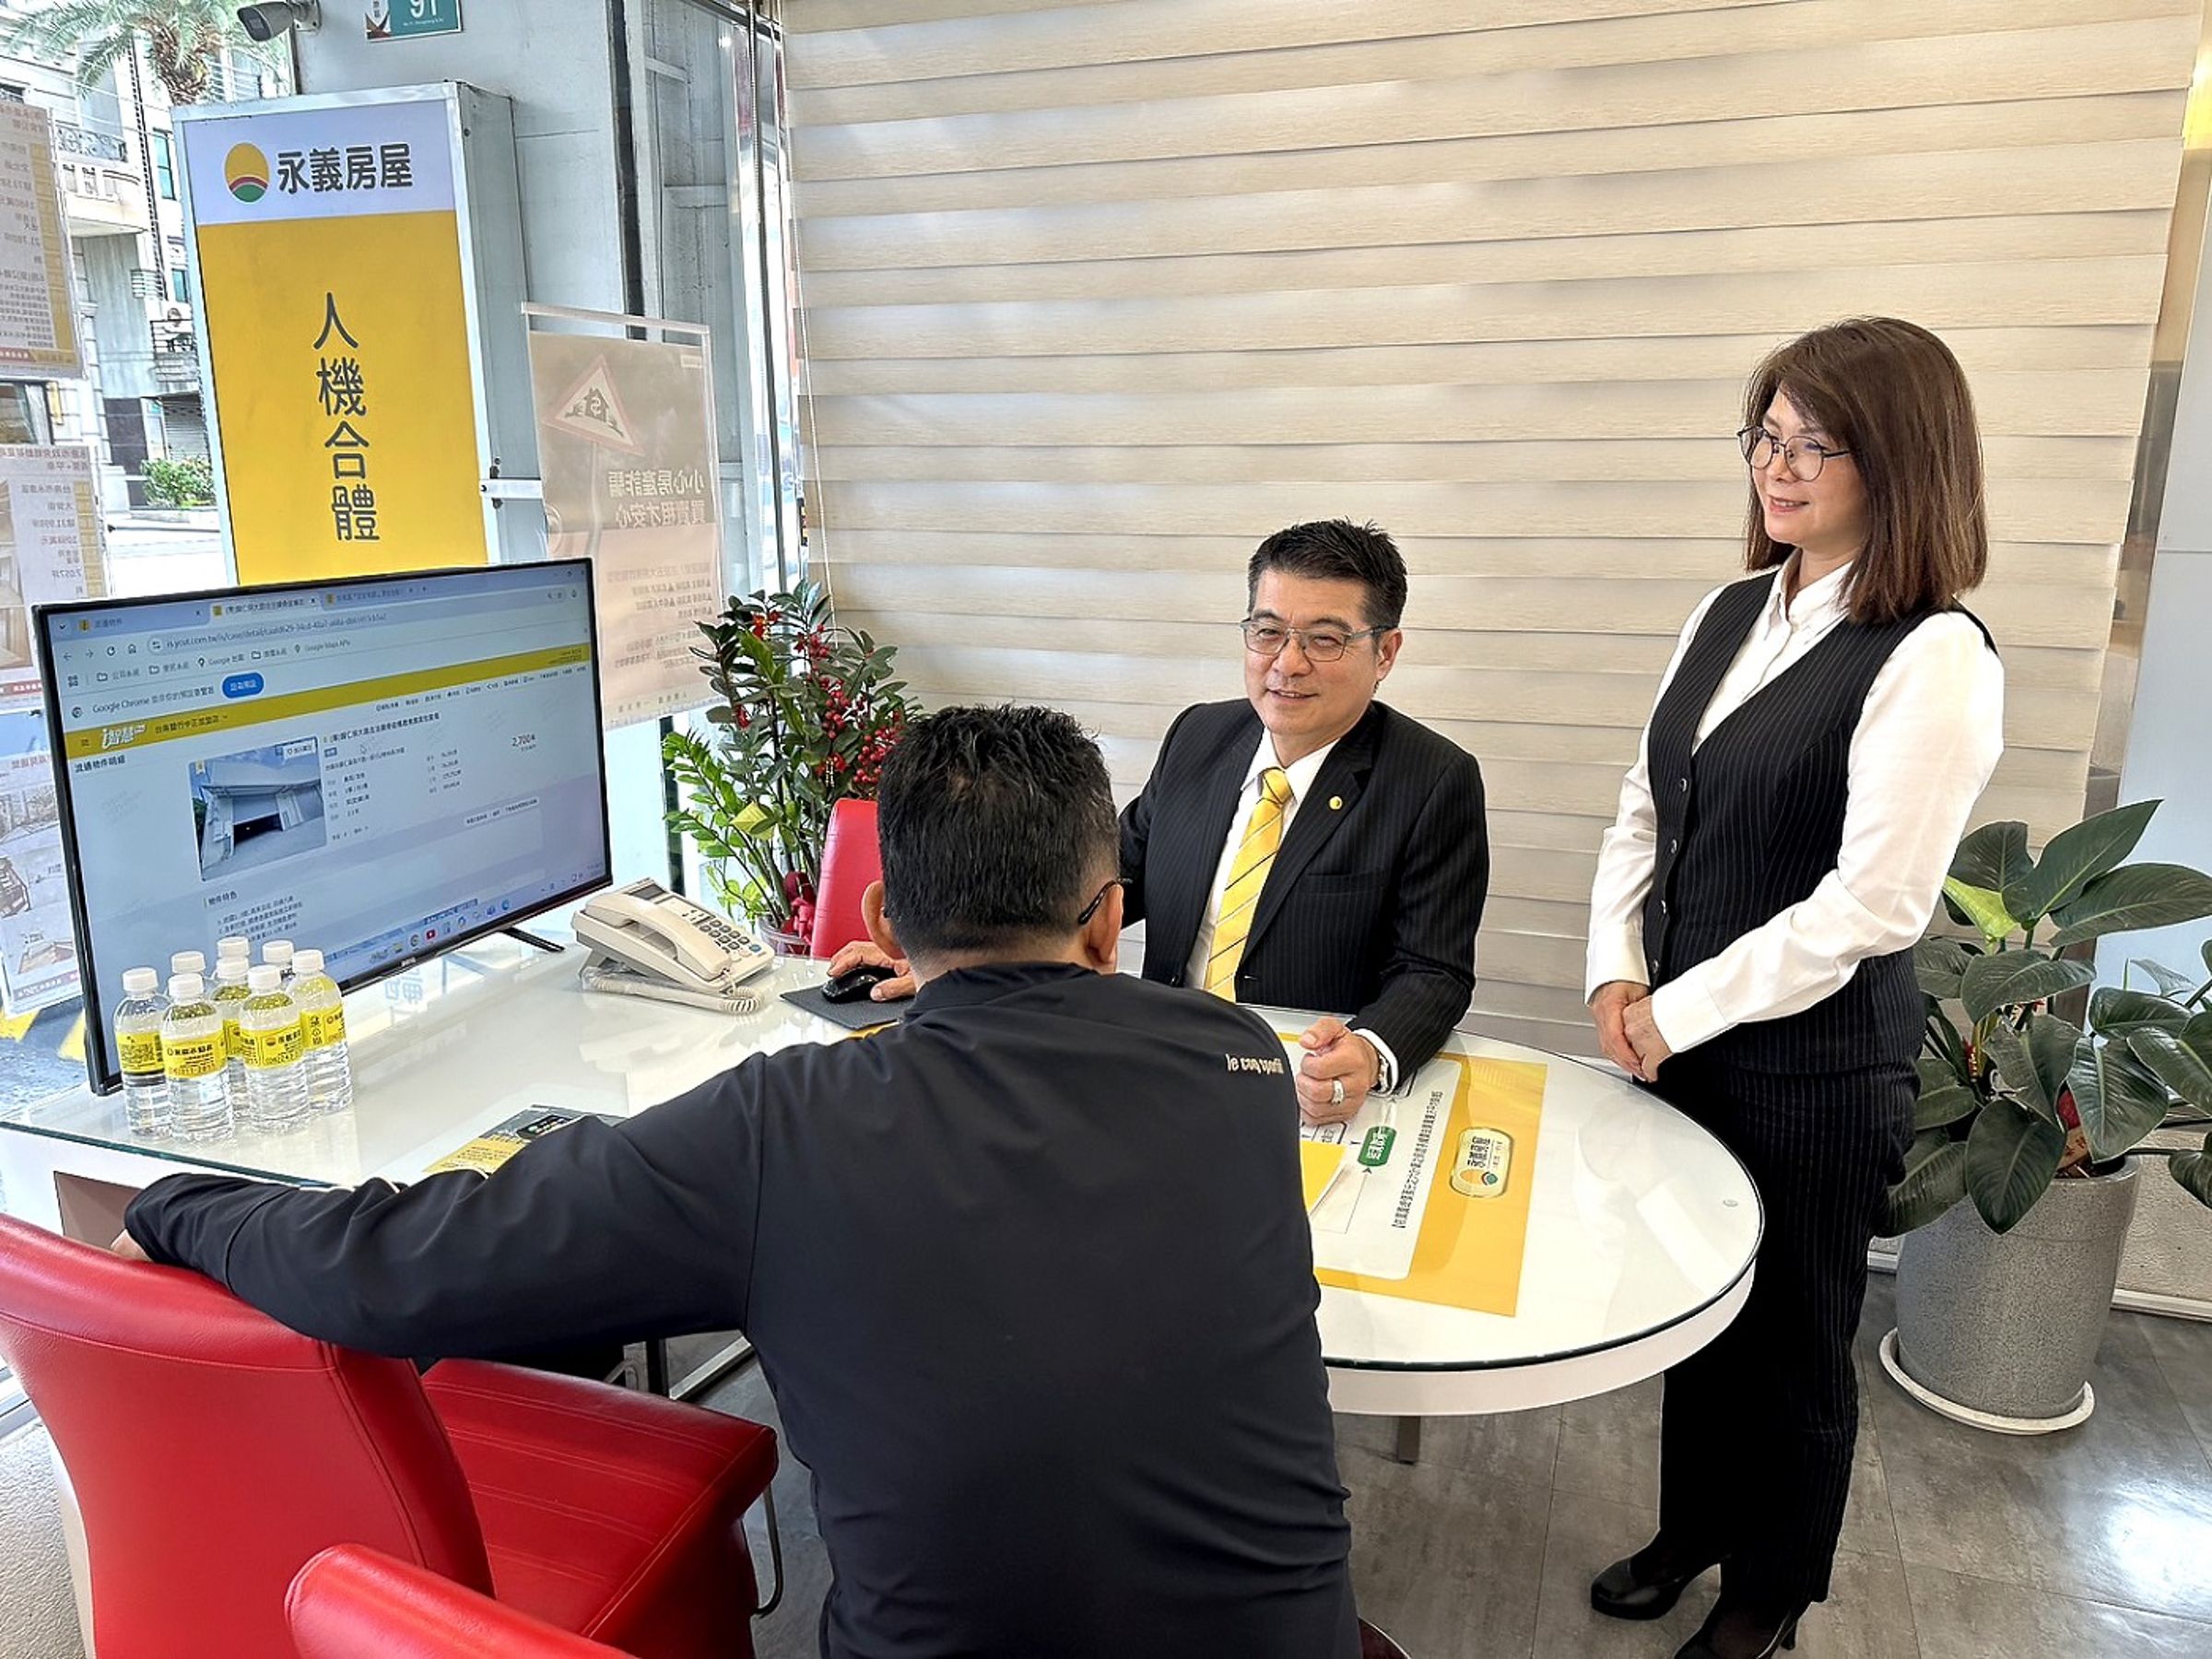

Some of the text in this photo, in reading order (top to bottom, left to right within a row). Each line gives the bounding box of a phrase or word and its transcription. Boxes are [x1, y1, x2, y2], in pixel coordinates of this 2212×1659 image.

[277, 143, 414, 194] 永義房屋
[312, 291, 380, 542] 人機合體
[92, 700, 121, 713] Google
[121, 697, 150, 709] Chrome
[1225, 1053, 1240, 1072] le
